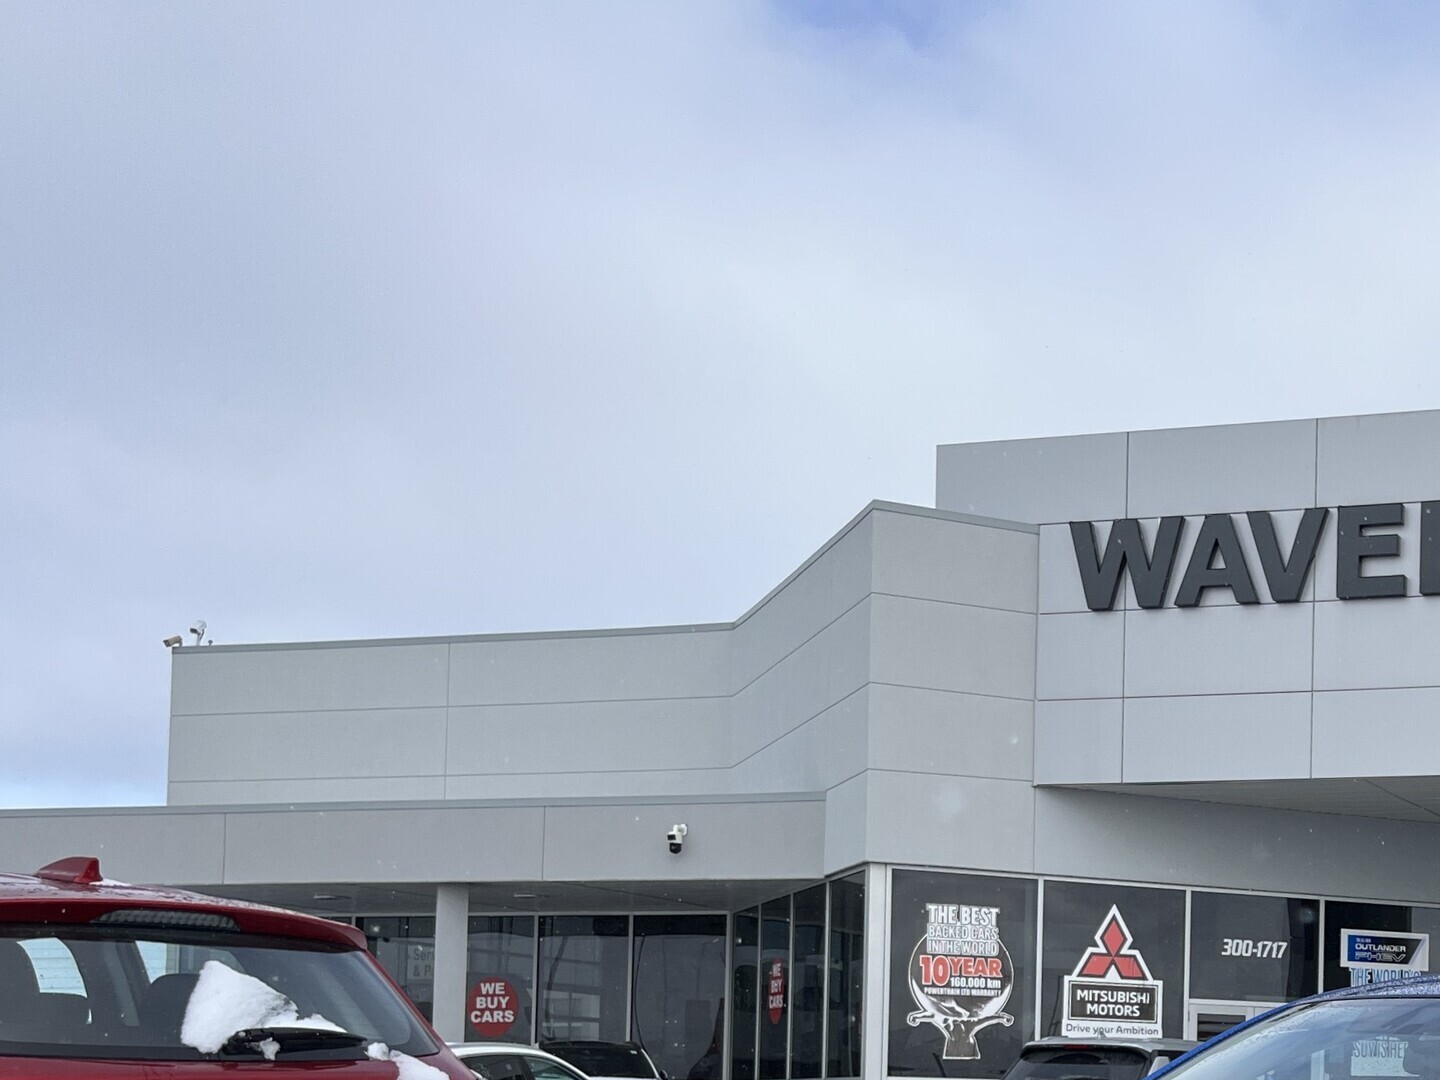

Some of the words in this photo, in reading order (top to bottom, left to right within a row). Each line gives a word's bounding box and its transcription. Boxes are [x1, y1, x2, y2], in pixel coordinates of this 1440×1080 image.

[927, 904, 959, 925] THE
[960, 906, 1000, 927] BEST
[928, 925, 968, 939] BACKED
[971, 927, 999, 941] CARS
[928, 941, 939, 953] IN
[940, 941, 960, 953] THE
[962, 942, 999, 955] WORLD
[1221, 938, 1288, 959] 300-1717
[1355, 943, 1407, 952] OUTLANDER
[1354, 951, 1406, 962] PHEV
[920, 955, 950, 986] 10
[948, 957, 1003, 978] YEAR
[1350, 967, 1371, 987] THE
[480, 982, 505, 995] WE
[950, 977, 985, 989] 160,000
[987, 978, 1002, 989] km
[924, 986, 960, 996] POWERTRAIN
[971, 988, 1002, 997] WARRANTY
[1076, 989, 1150, 1004] MITSUBISHI
[475, 996, 510, 1009] BUY
[470, 1010, 515, 1023] CARS
[1086, 1004, 1140, 1017] MOTORS
[1066, 1023, 1091, 1033] Drive
[1092, 1026, 1114, 1035] your
[1115, 1025, 1159, 1035] Ambition
